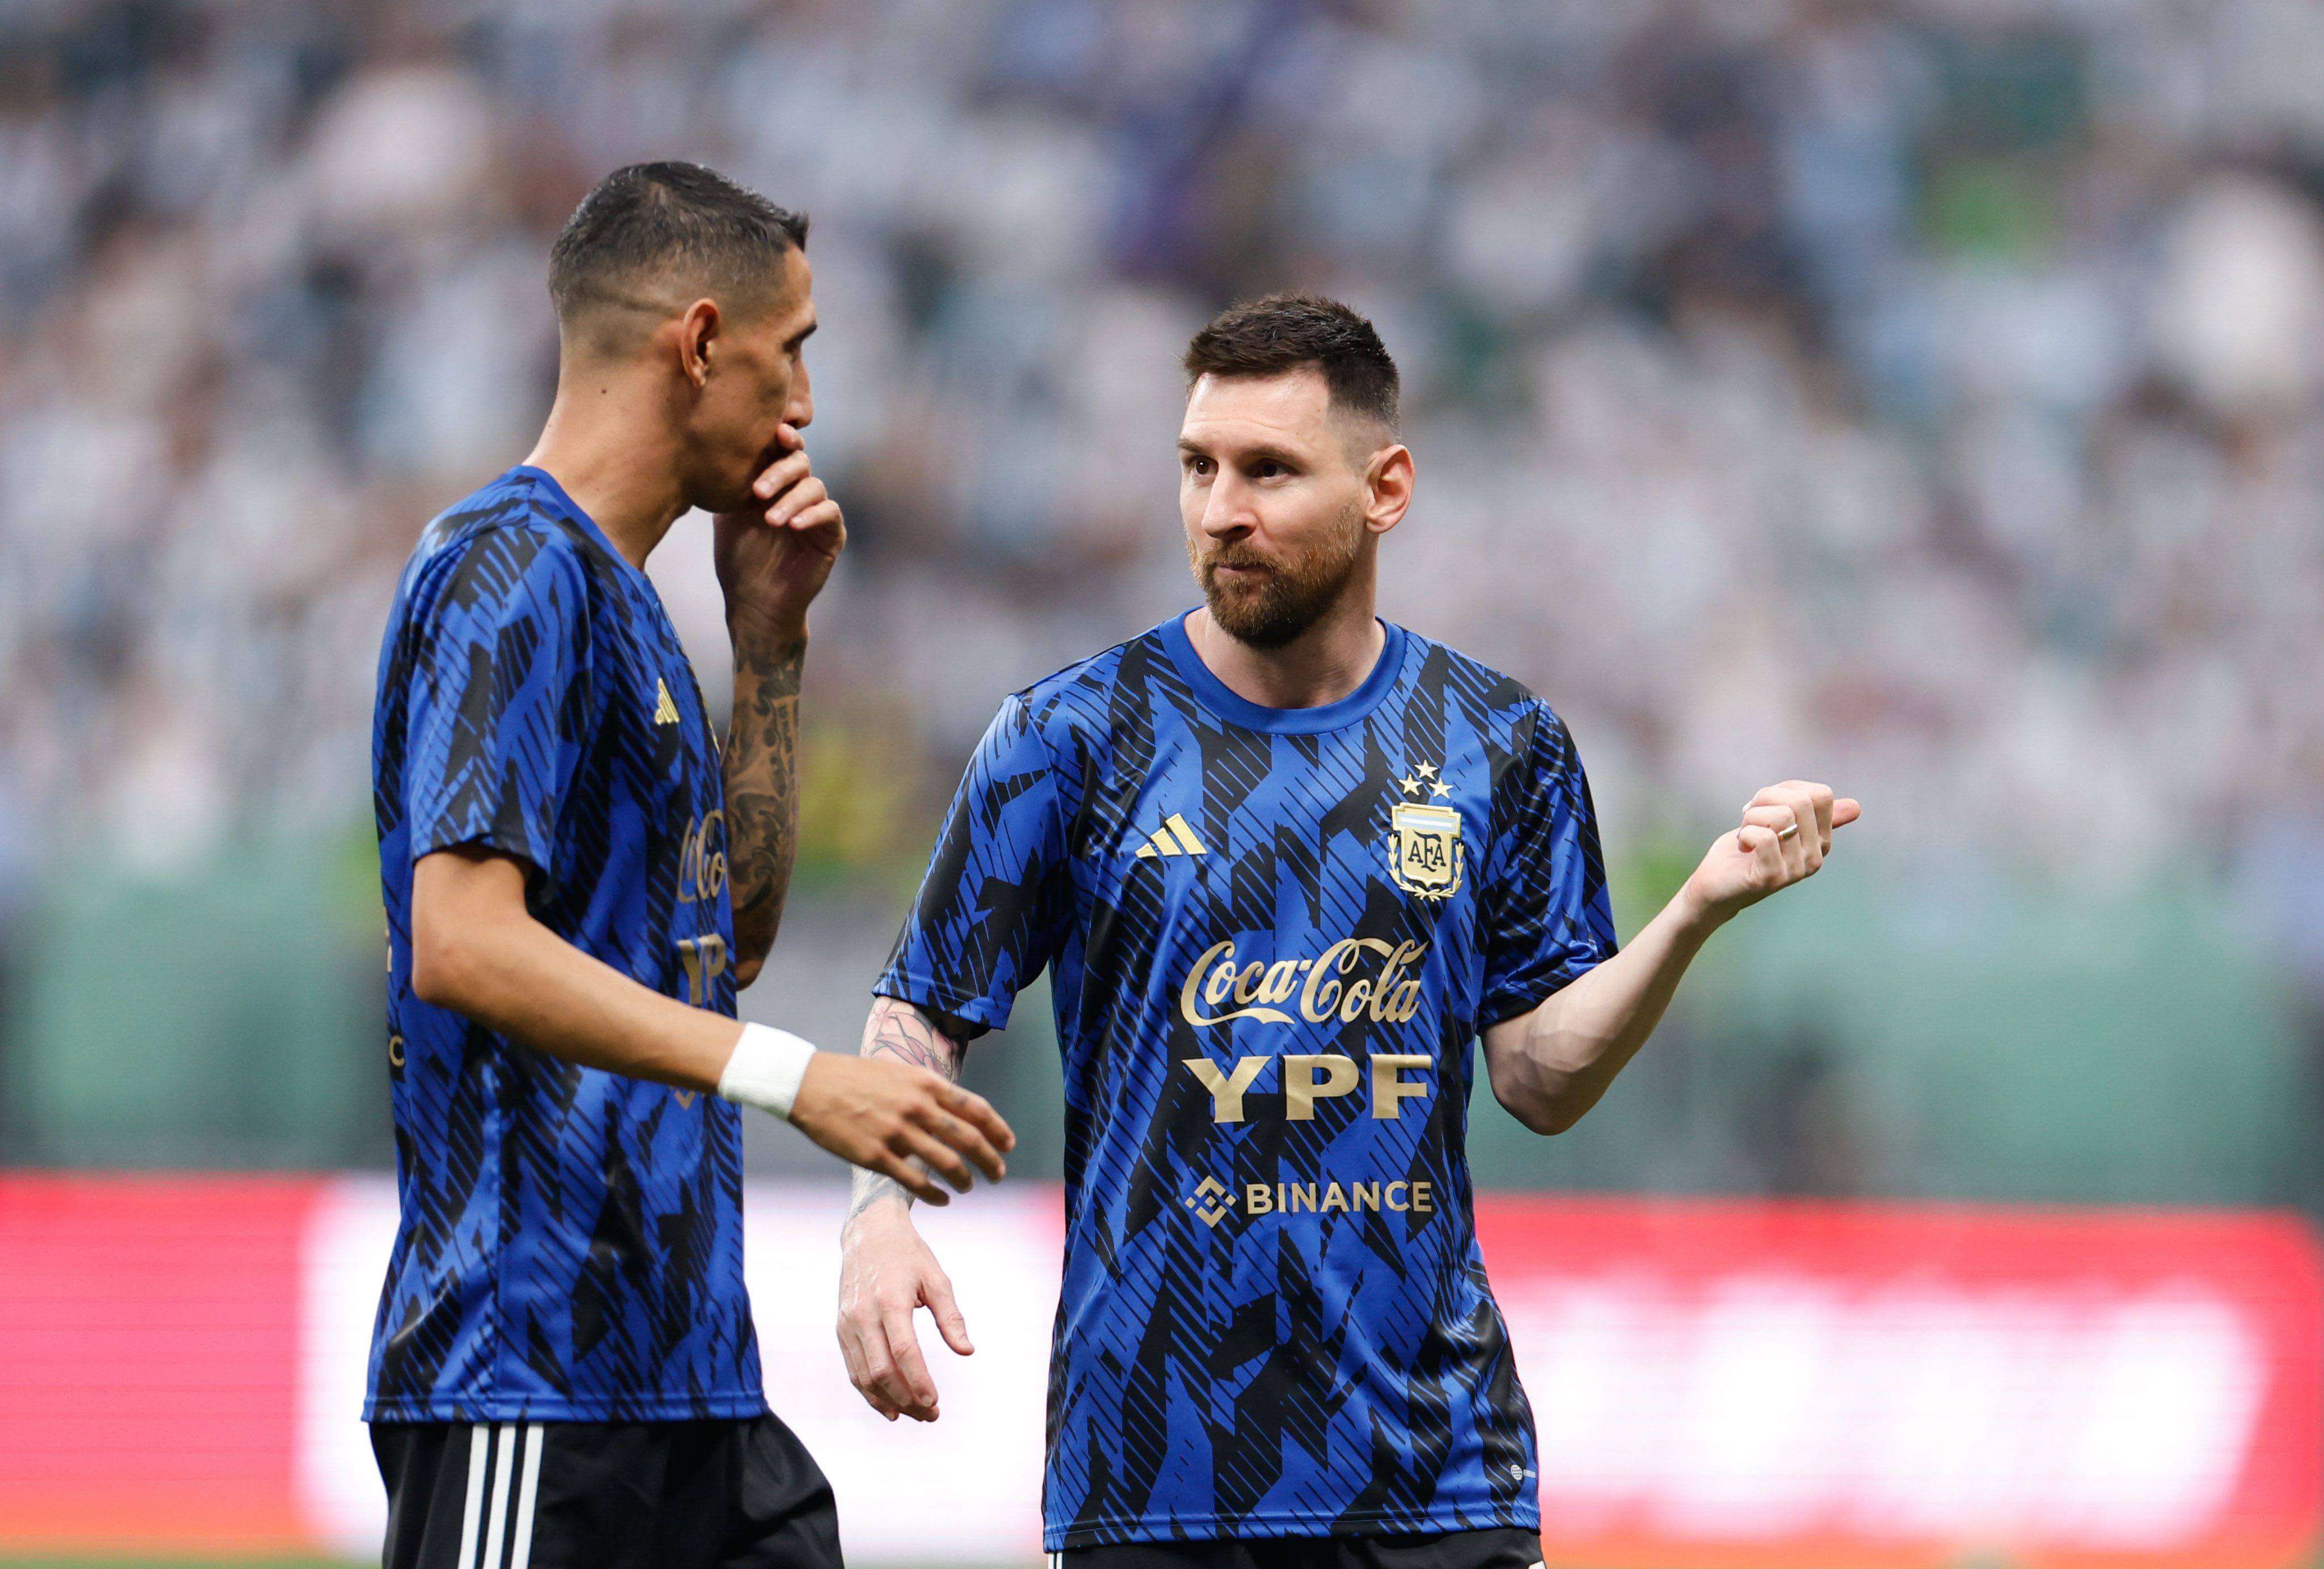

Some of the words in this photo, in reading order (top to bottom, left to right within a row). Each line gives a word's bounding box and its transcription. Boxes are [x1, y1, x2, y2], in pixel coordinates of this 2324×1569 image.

[1407, 829, 1447, 872] AFA
[1181, 938, 1428, 1026] Coca-Cola
[1182, 1054, 1432, 1123] YPF
[1246, 1180, 1432, 1215] BINANCE
